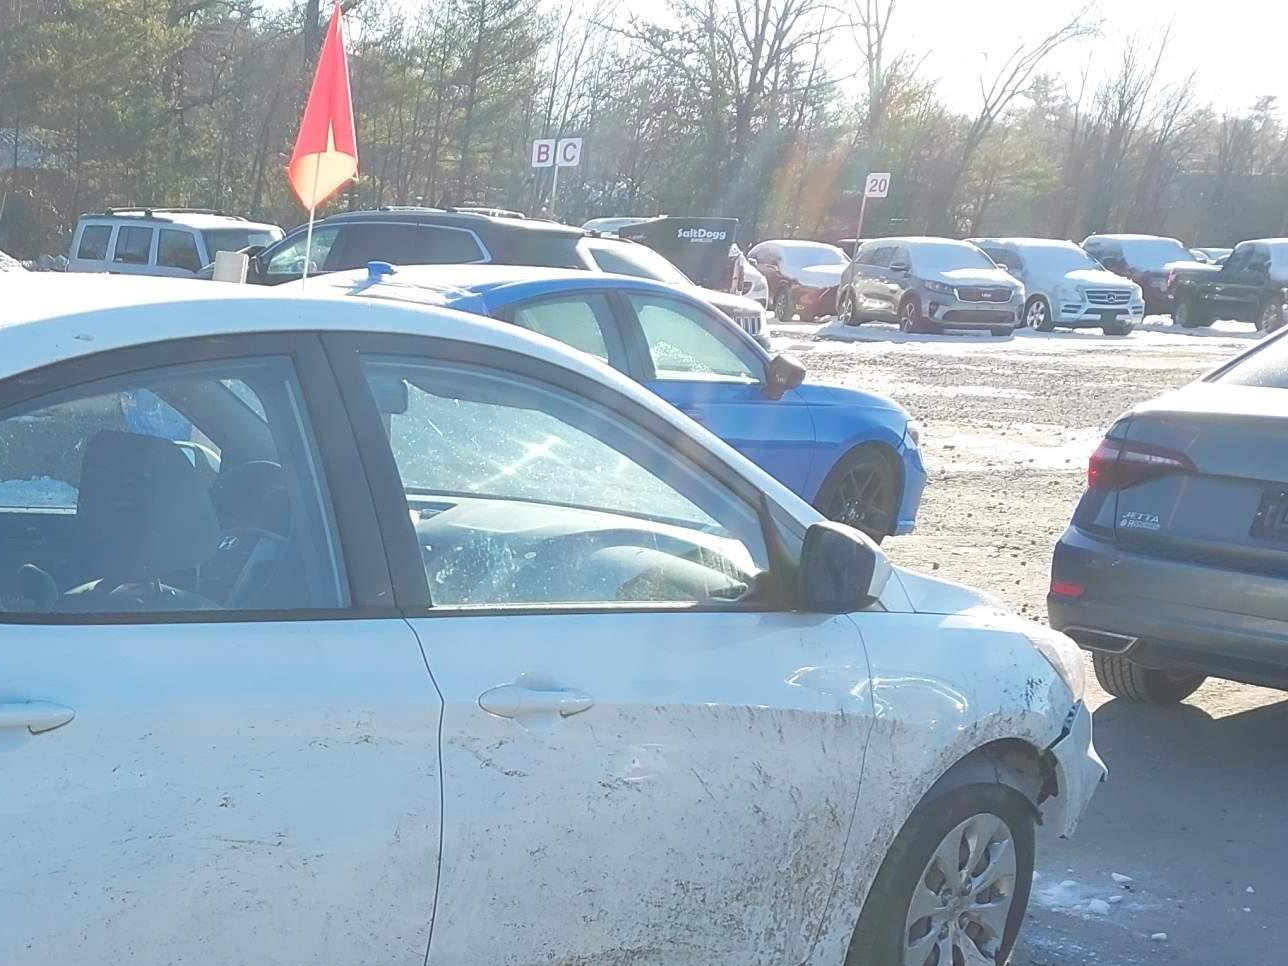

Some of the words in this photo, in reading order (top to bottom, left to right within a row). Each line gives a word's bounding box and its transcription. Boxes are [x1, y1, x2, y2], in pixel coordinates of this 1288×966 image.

[536, 143, 550, 163] B
[563, 142, 577, 162] C
[869, 178, 888, 193] 20
[677, 227, 727, 241] SaltDogg
